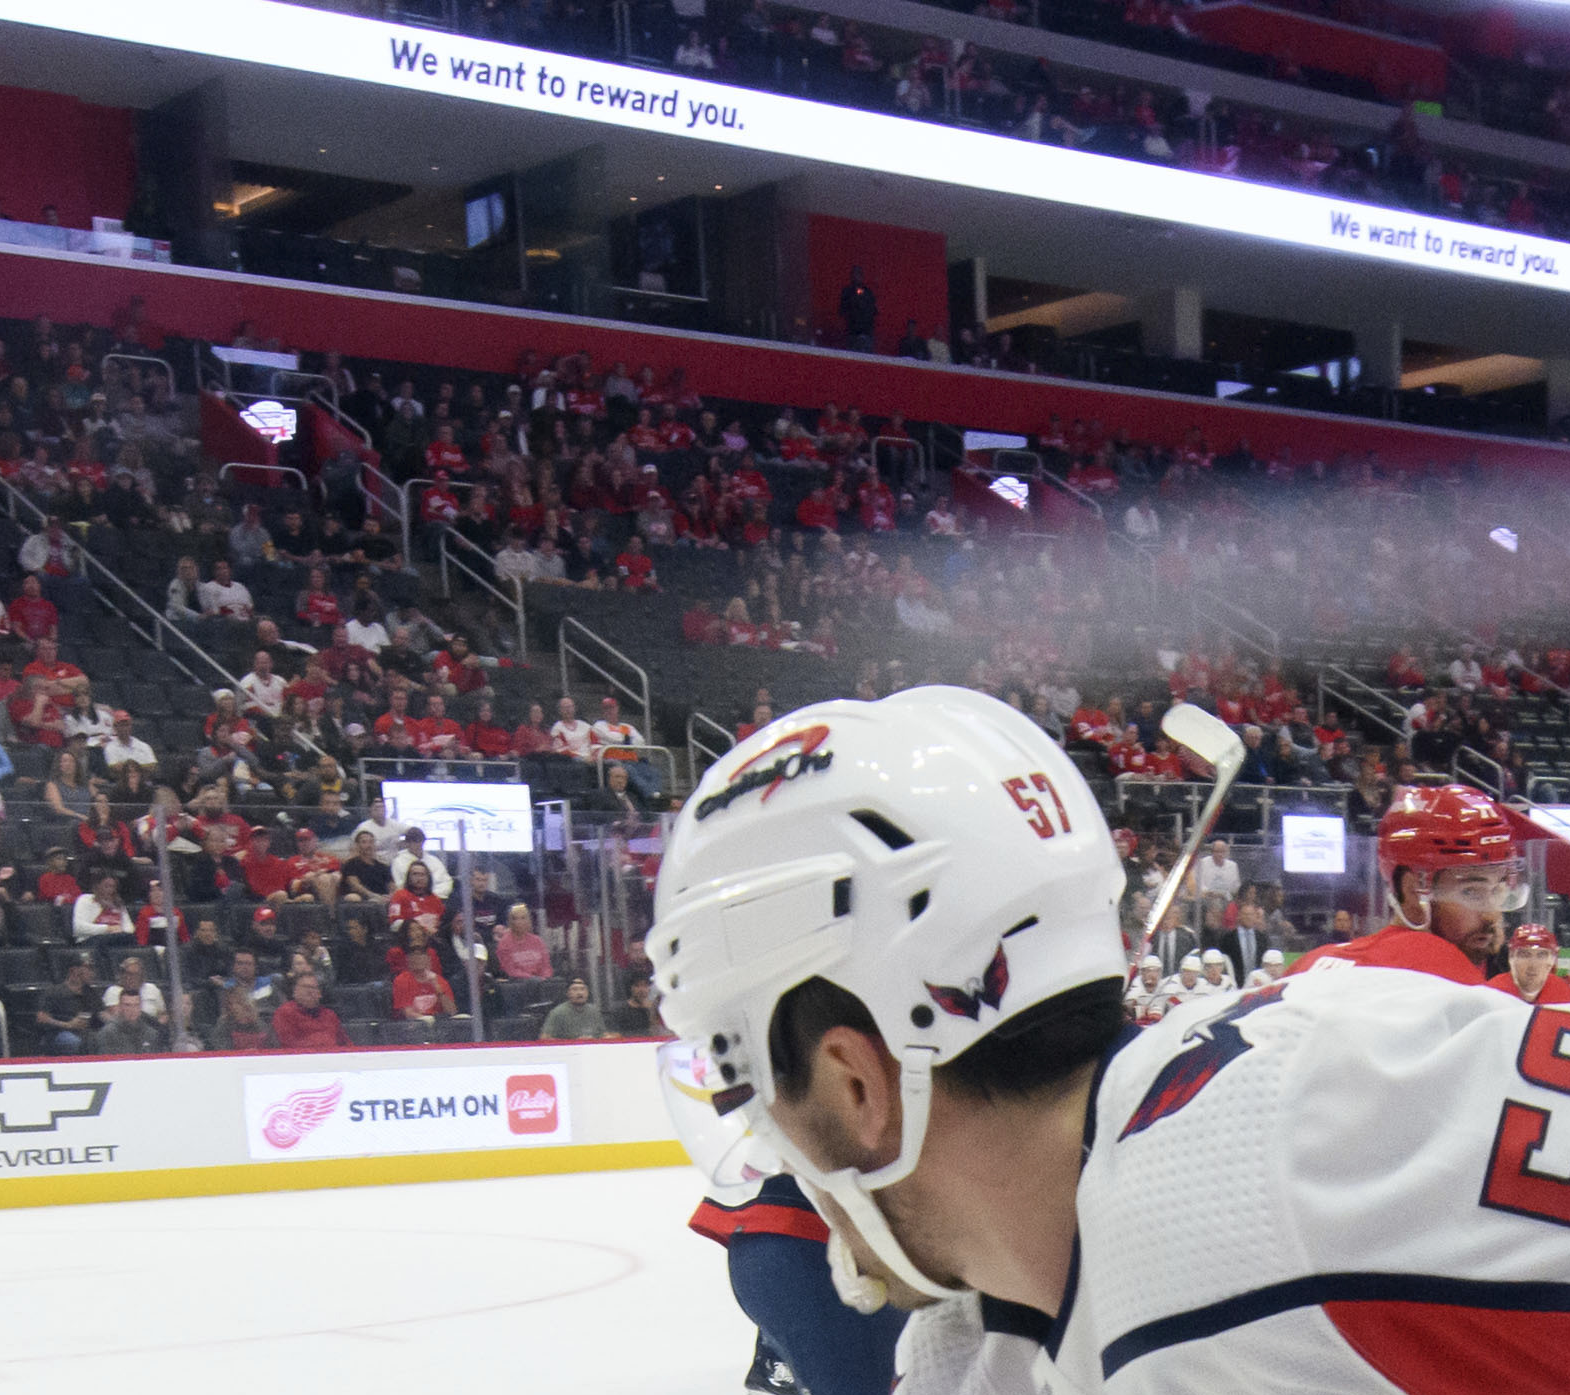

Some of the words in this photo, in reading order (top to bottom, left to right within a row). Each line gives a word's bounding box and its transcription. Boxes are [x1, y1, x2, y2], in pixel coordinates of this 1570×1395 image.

[390, 37, 438, 75] We
[450, 56, 526, 92] want
[537, 66, 566, 98] to
[577, 79, 679, 118] reward
[686, 99, 745, 130] you.
[1330, 210, 1361, 239] We
[1368, 226, 1417, 250] want
[1424, 230, 1443, 254] to
[1450, 238, 1517, 267] reward
[1520, 251, 1560, 275] you.
[1001, 772, 1073, 840] 57
[349, 1095, 456, 1122] STREAM
[463, 1094, 499, 1117] ON
